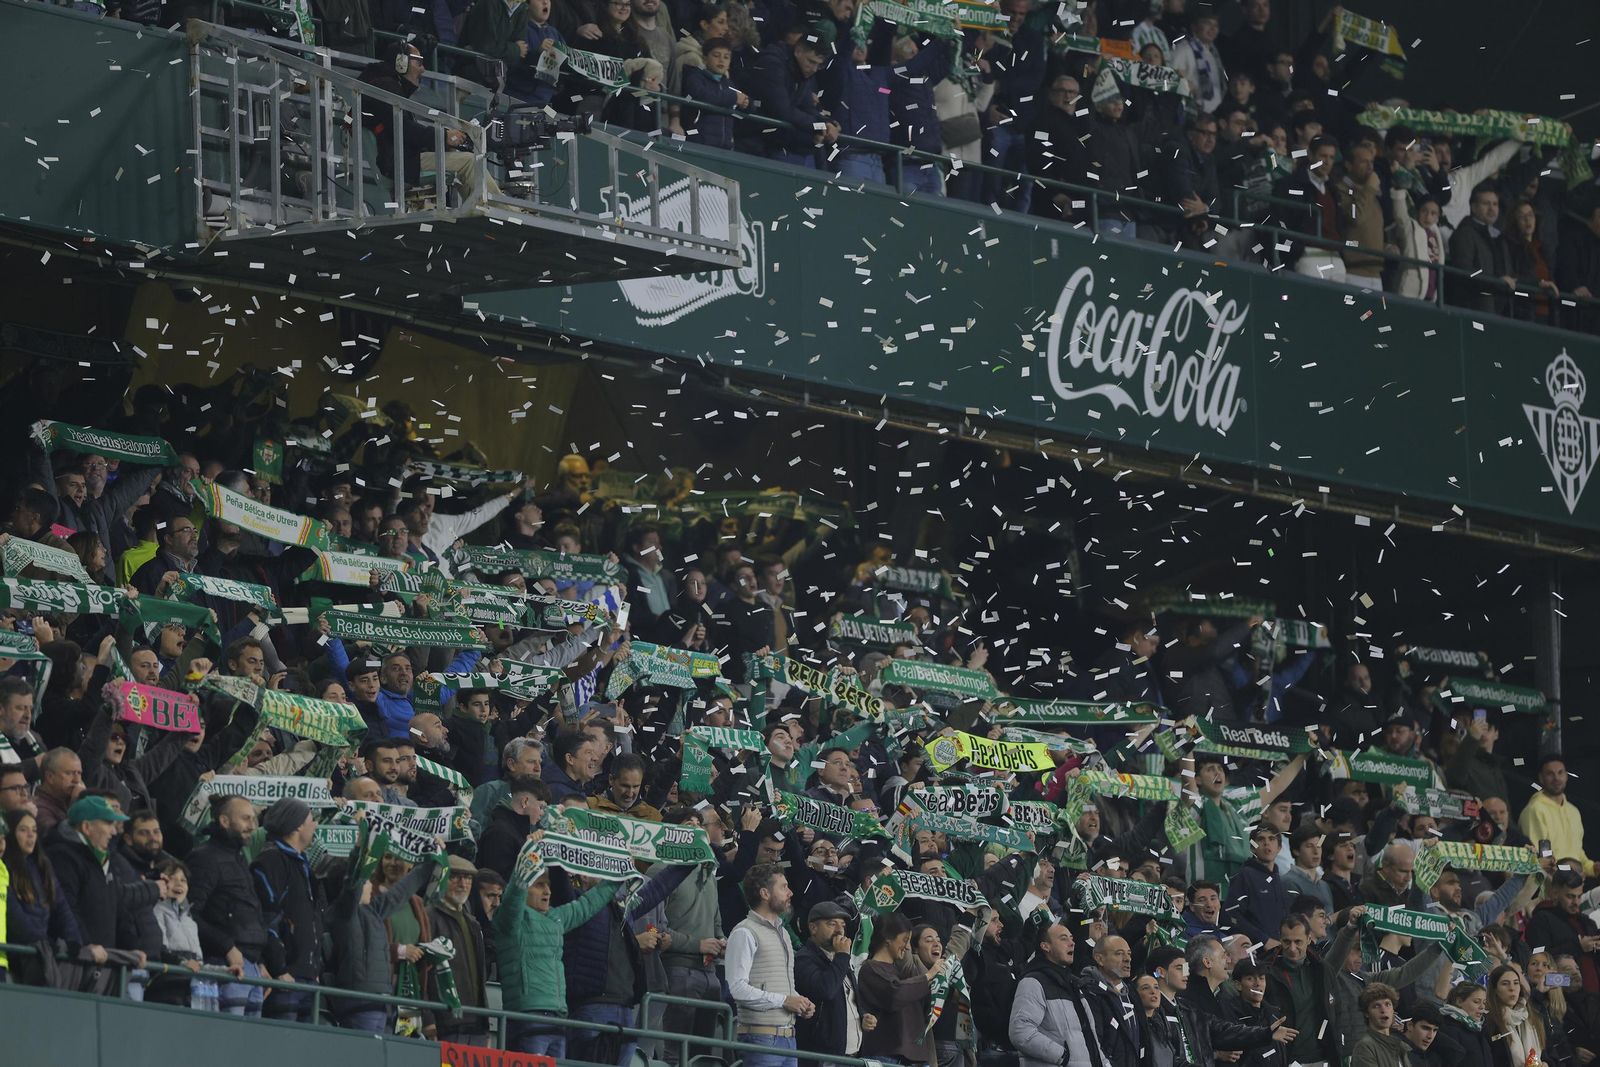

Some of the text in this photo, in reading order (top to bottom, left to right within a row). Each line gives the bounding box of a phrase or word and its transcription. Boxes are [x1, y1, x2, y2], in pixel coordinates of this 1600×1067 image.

[1047, 266, 1250, 431] Coca-Cola
[225, 494, 243, 509] Peña
[244, 503, 265, 519] Bética
[266, 511, 275, 520] de
[276, 515, 298, 528] Utrera
[336, 618, 463, 643] RealBetisBalompié
[788, 660, 830, 694] REAL
[588, 812, 620, 833] tuyos
[326, 829, 353, 844] BETIS
[664, 826, 695, 844] tuyos
[655, 842, 707, 863] siempre
